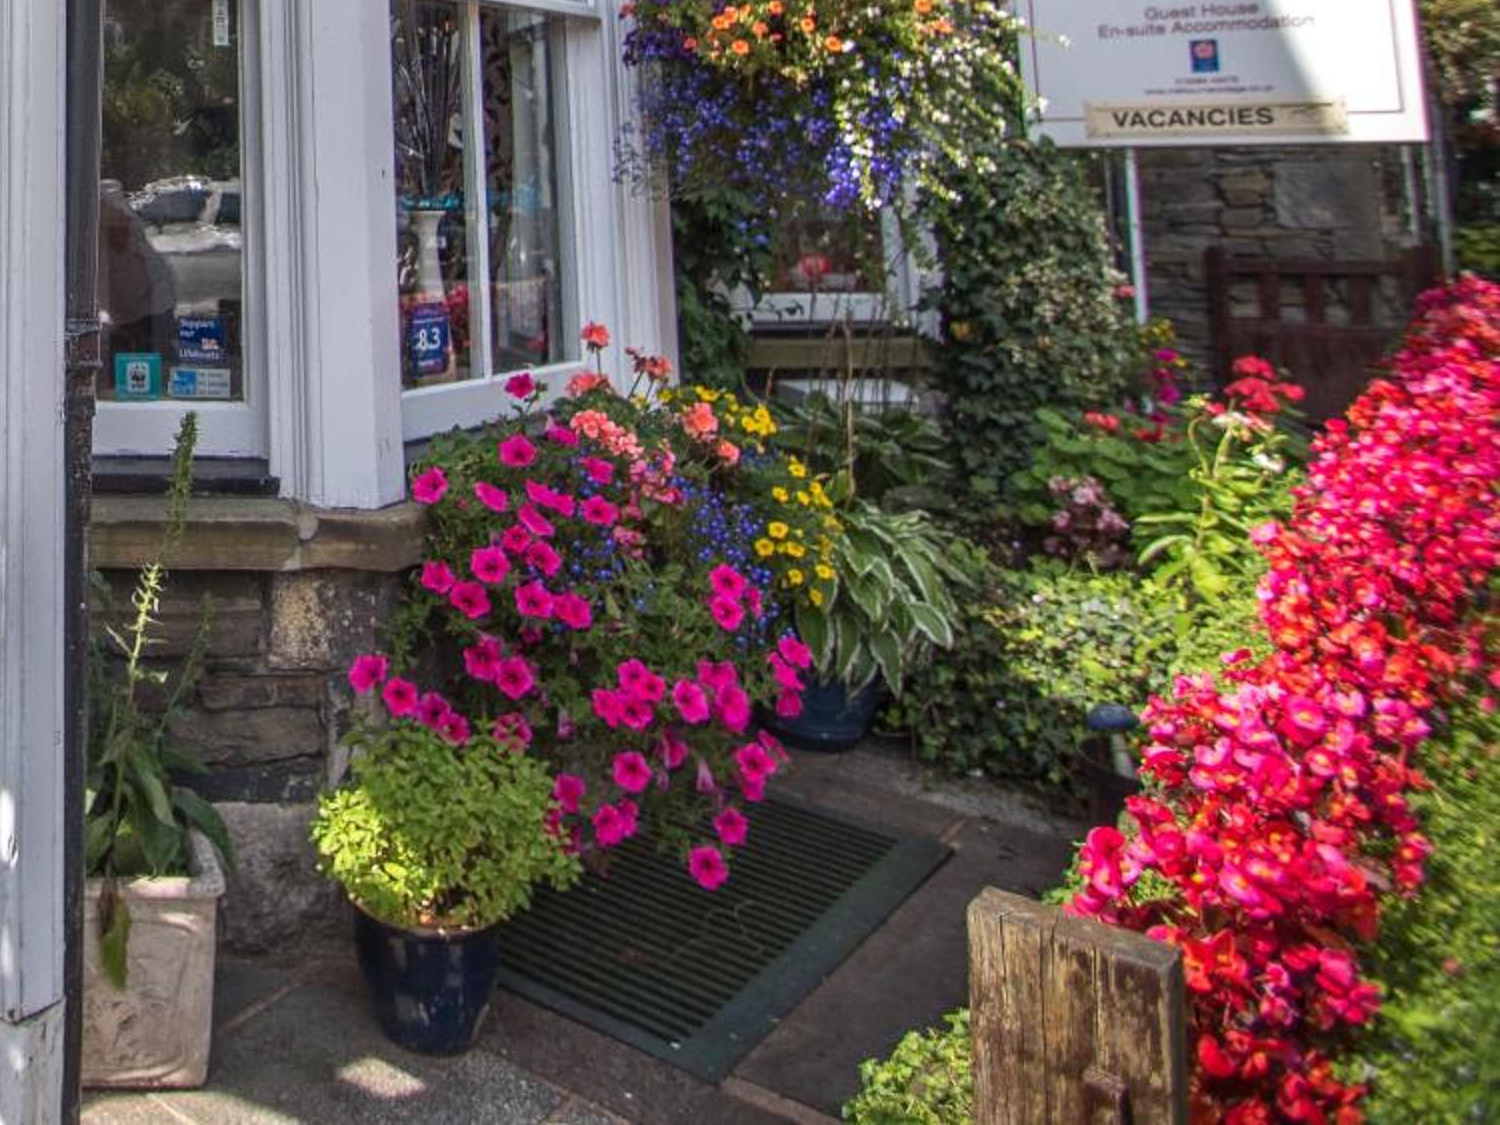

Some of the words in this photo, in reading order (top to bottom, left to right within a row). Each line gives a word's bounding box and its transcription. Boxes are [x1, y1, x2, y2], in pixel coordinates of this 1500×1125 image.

[1143, 6, 1196, 22] Guest
[1201, 2, 1259, 17] House
[1097, 23, 1166, 39] En-suite
[1171, 13, 1315, 35] Accommodation
[1112, 106, 1275, 129] VACANCIES
